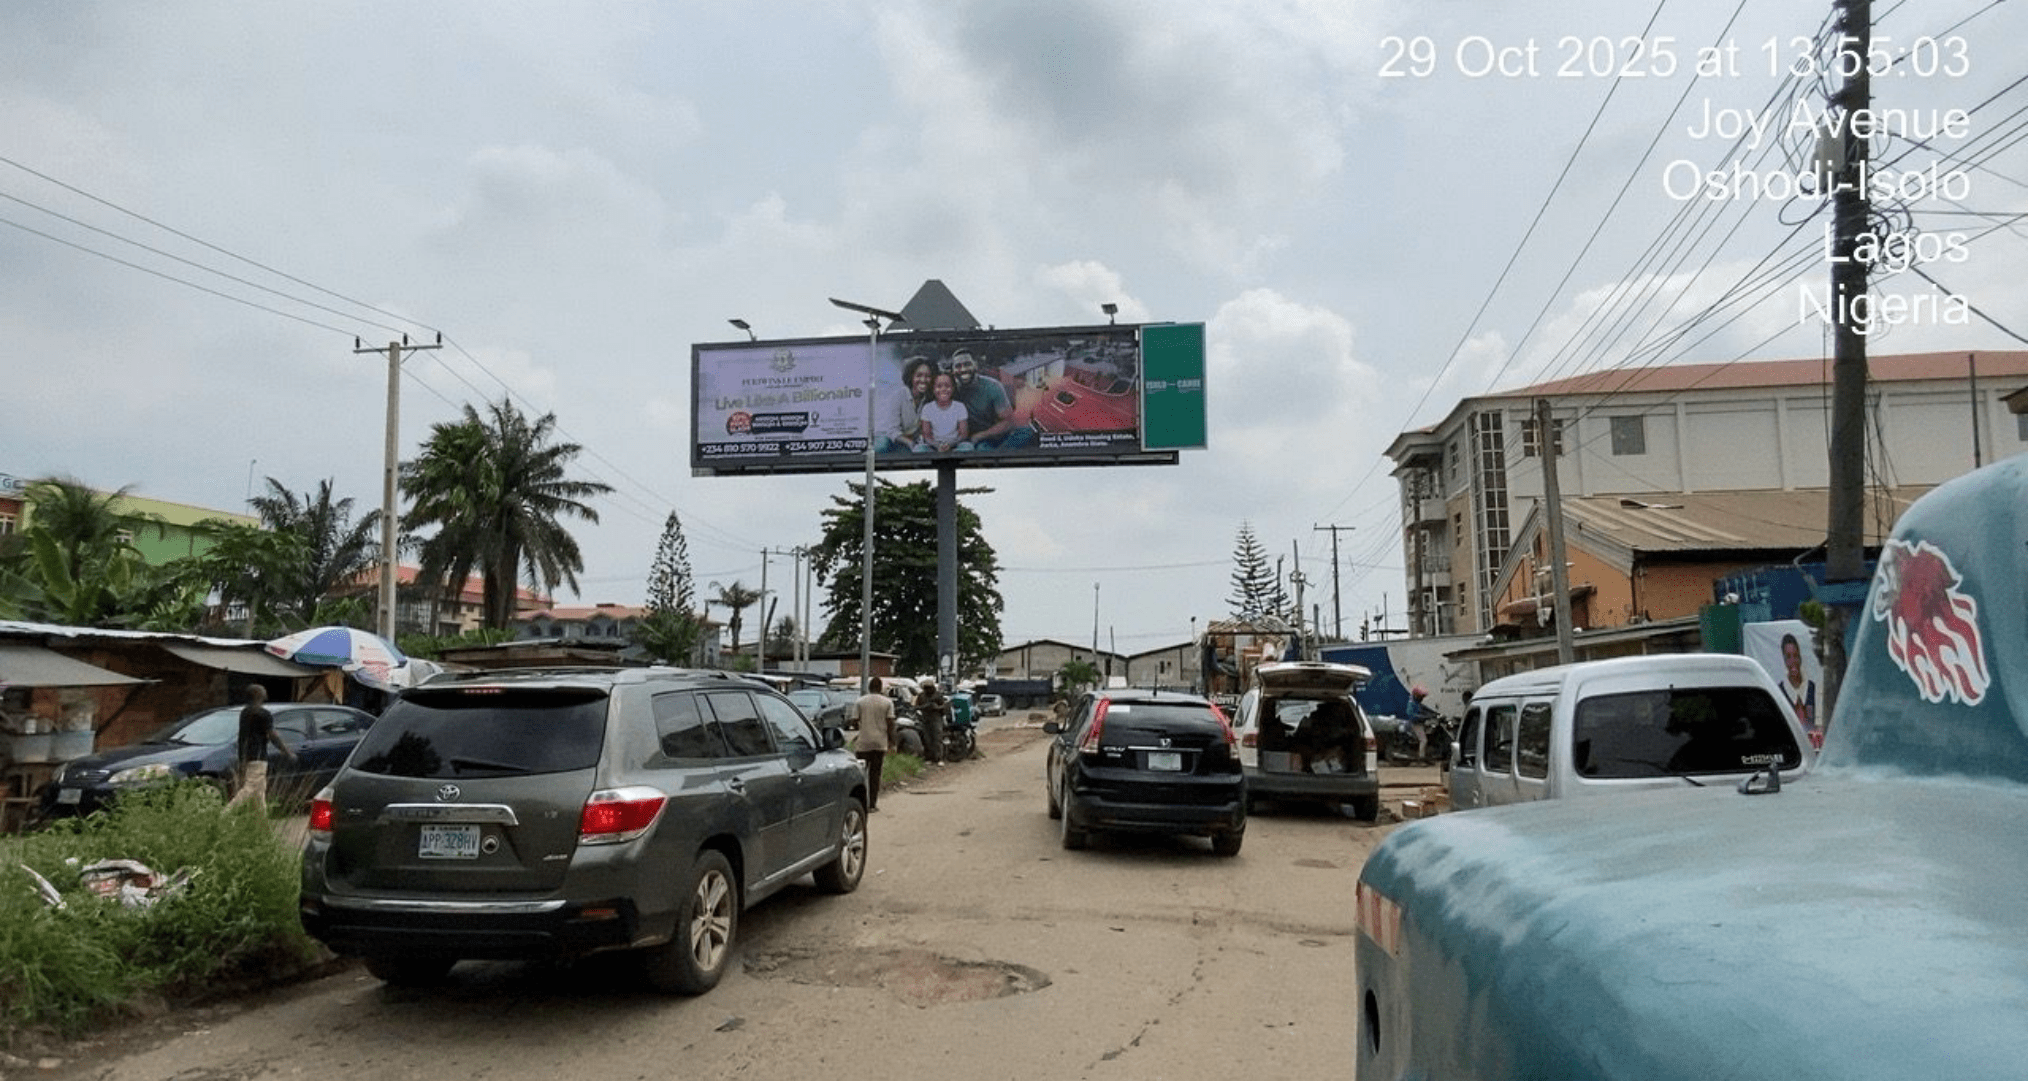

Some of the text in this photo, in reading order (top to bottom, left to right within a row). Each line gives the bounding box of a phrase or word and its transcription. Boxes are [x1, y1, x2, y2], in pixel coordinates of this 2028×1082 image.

[715, 386, 863, 411] Live Like A Billionaire
[1085, 433, 1111, 441] Housing
[701, 444, 722, 454] +234
[785, 441, 807, 451] +234
[808, 441, 825, 450] 907
[826, 440, 843, 450] 230
